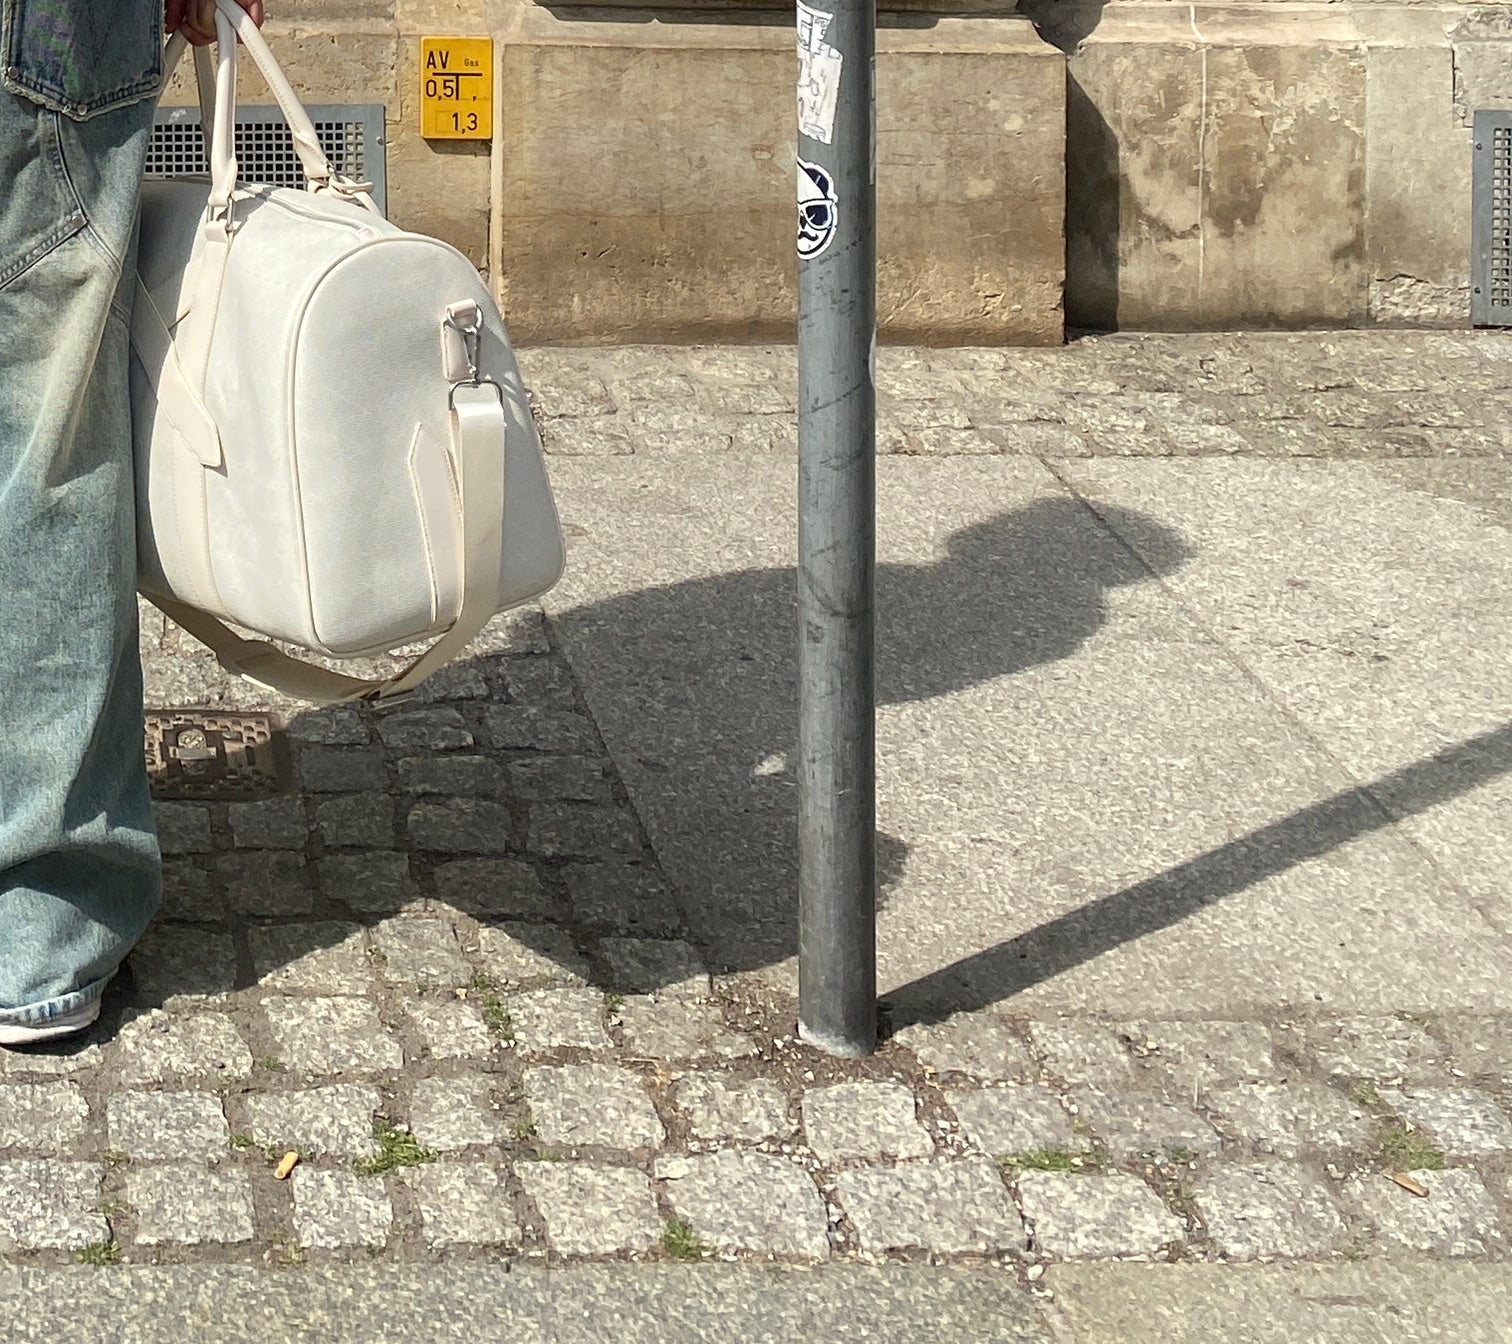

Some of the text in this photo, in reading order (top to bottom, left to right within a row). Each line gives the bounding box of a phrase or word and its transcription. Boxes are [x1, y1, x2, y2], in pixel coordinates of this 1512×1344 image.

[426, 50, 480, 70] AV Gas
[425, 78, 455, 101] 0,5
[451, 111, 478, 135] 1,3
